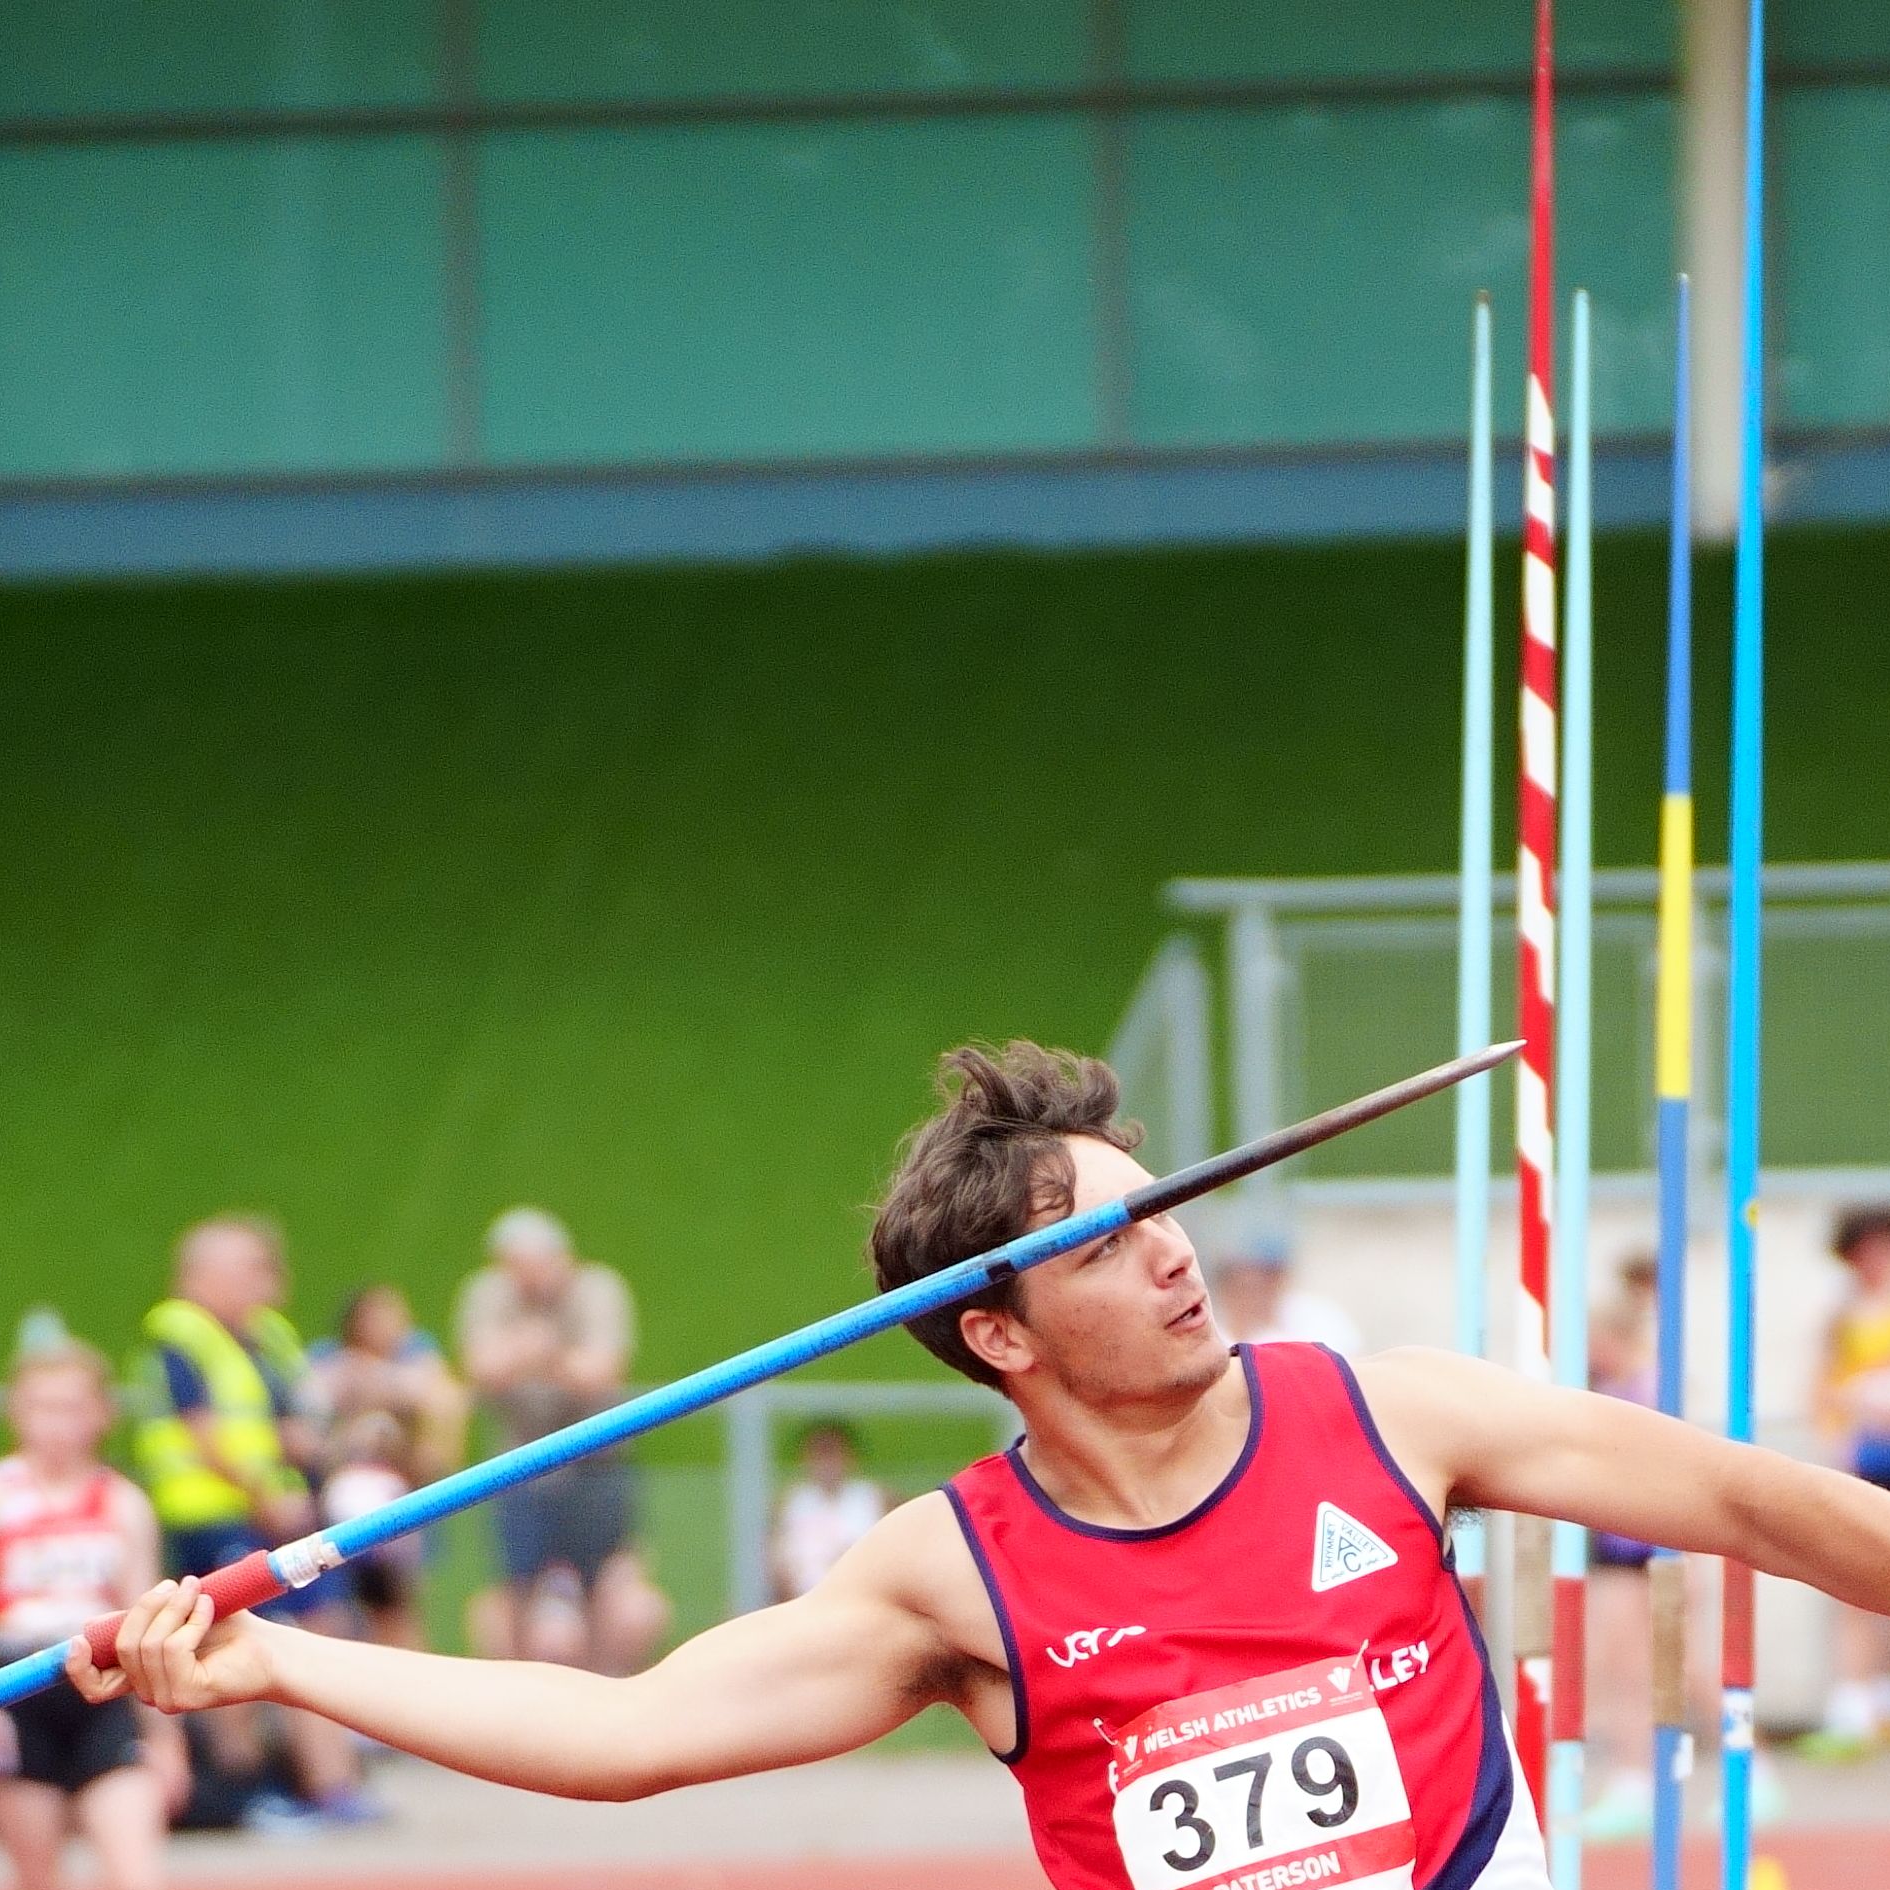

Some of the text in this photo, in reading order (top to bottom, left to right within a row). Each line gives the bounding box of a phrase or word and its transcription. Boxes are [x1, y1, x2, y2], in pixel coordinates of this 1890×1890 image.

[1341, 1523, 1377, 1552] VALLEY
[1143, 1716, 1210, 1754] WELSH
[1213, 1686, 1323, 1732] ATHLETICS
[1149, 1735, 1359, 1872] 379
